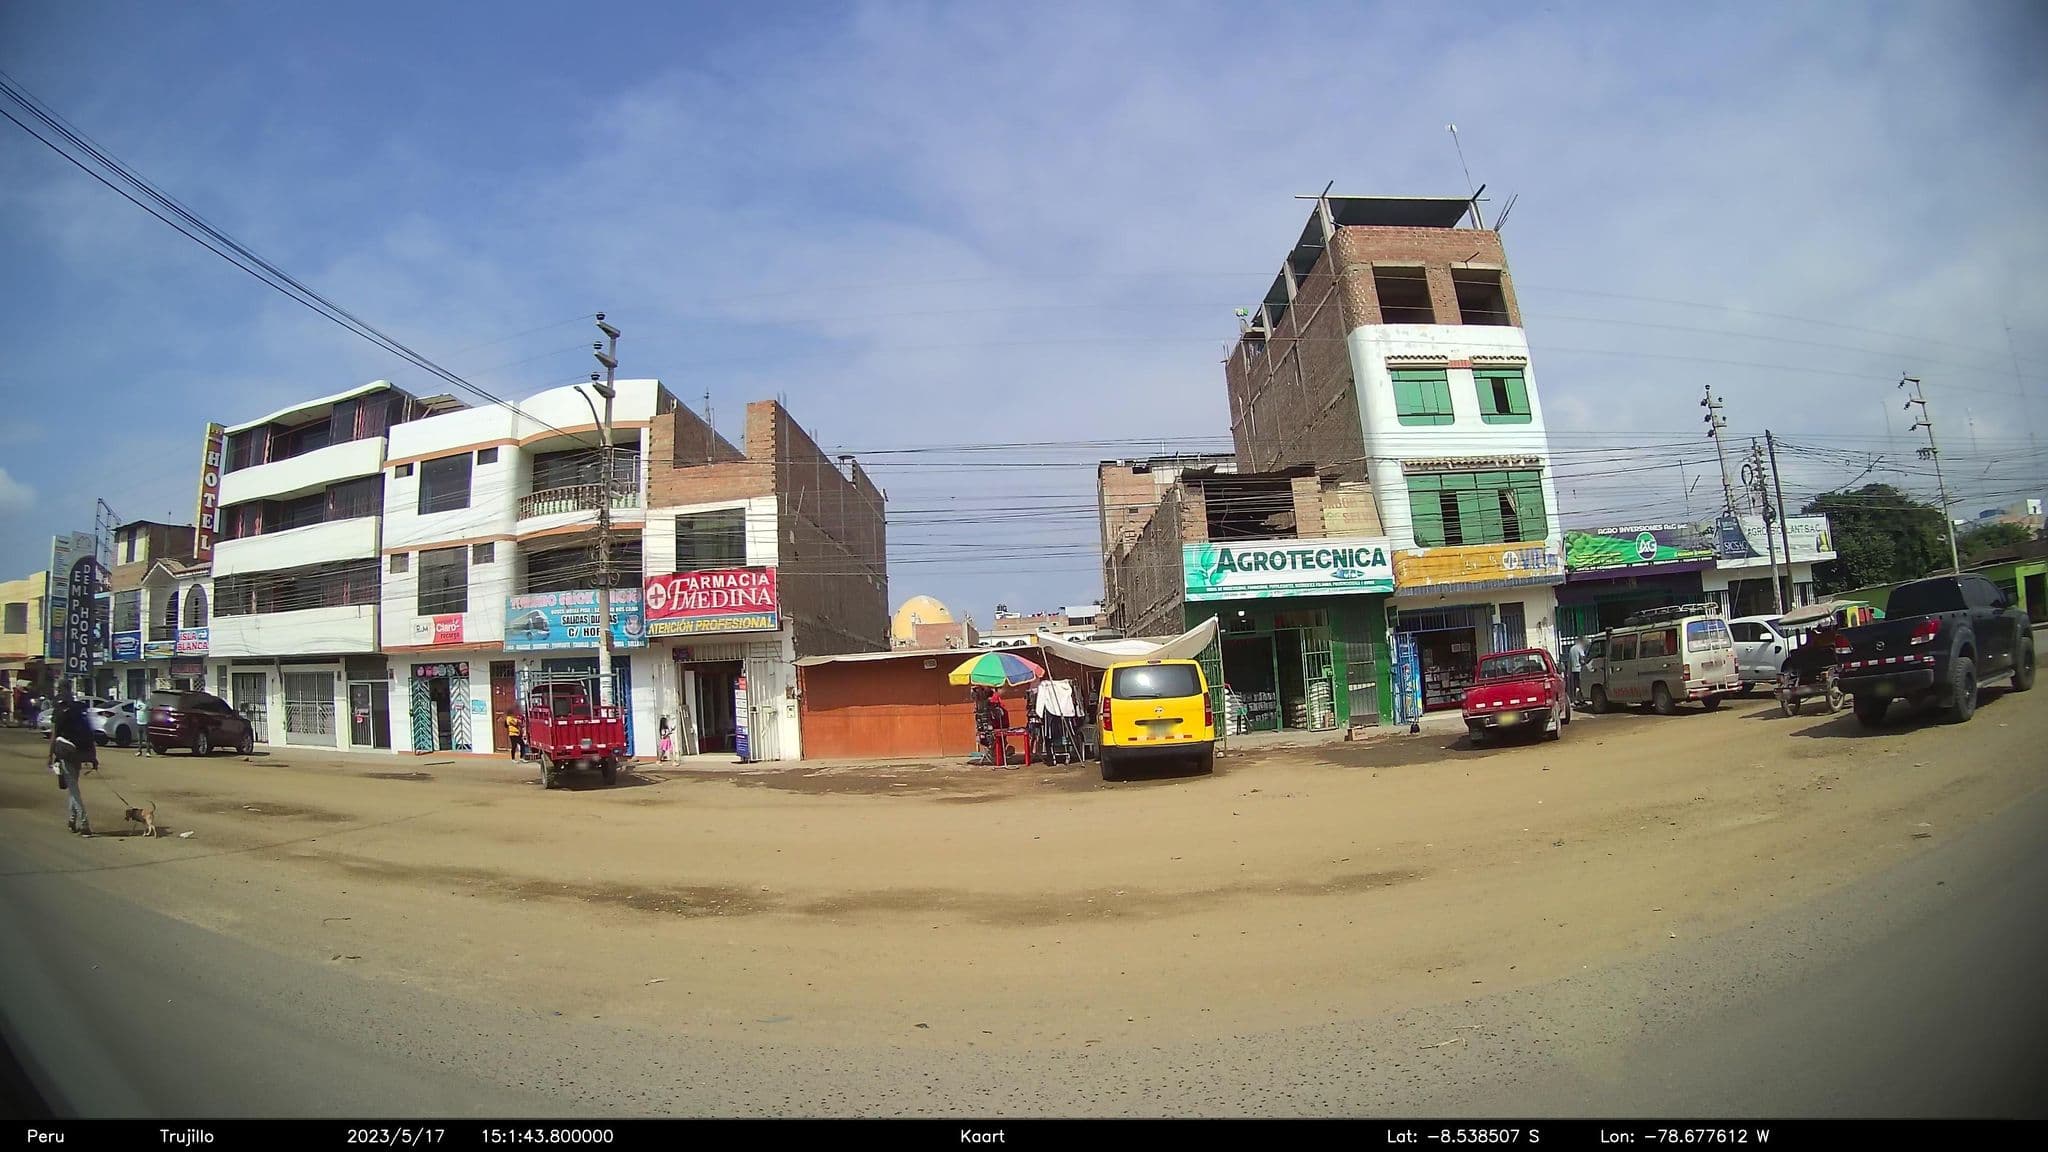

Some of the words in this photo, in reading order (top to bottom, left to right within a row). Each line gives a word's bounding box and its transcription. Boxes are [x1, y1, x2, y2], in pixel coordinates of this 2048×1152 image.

[200, 451, 220, 551] HOTEL
[1597, 527, 1618, 535] AGRO
[1619, 524, 1663, 534] INVERSIONES
[1216, 547, 1387, 573] AGROTECNICA
[83, 564, 91, 596] DEL
[677, 587, 775, 610] MEDINA
[69, 570, 82, 669] EMPORIO
[561, 614, 588, 625] SALIDAS
[649, 619, 693, 634] ATENCIÓN
[695, 616, 775, 630] PROFESIONAL
[79, 606, 89, 672] HOGAR
[177, 641, 209, 651] BLANCA
